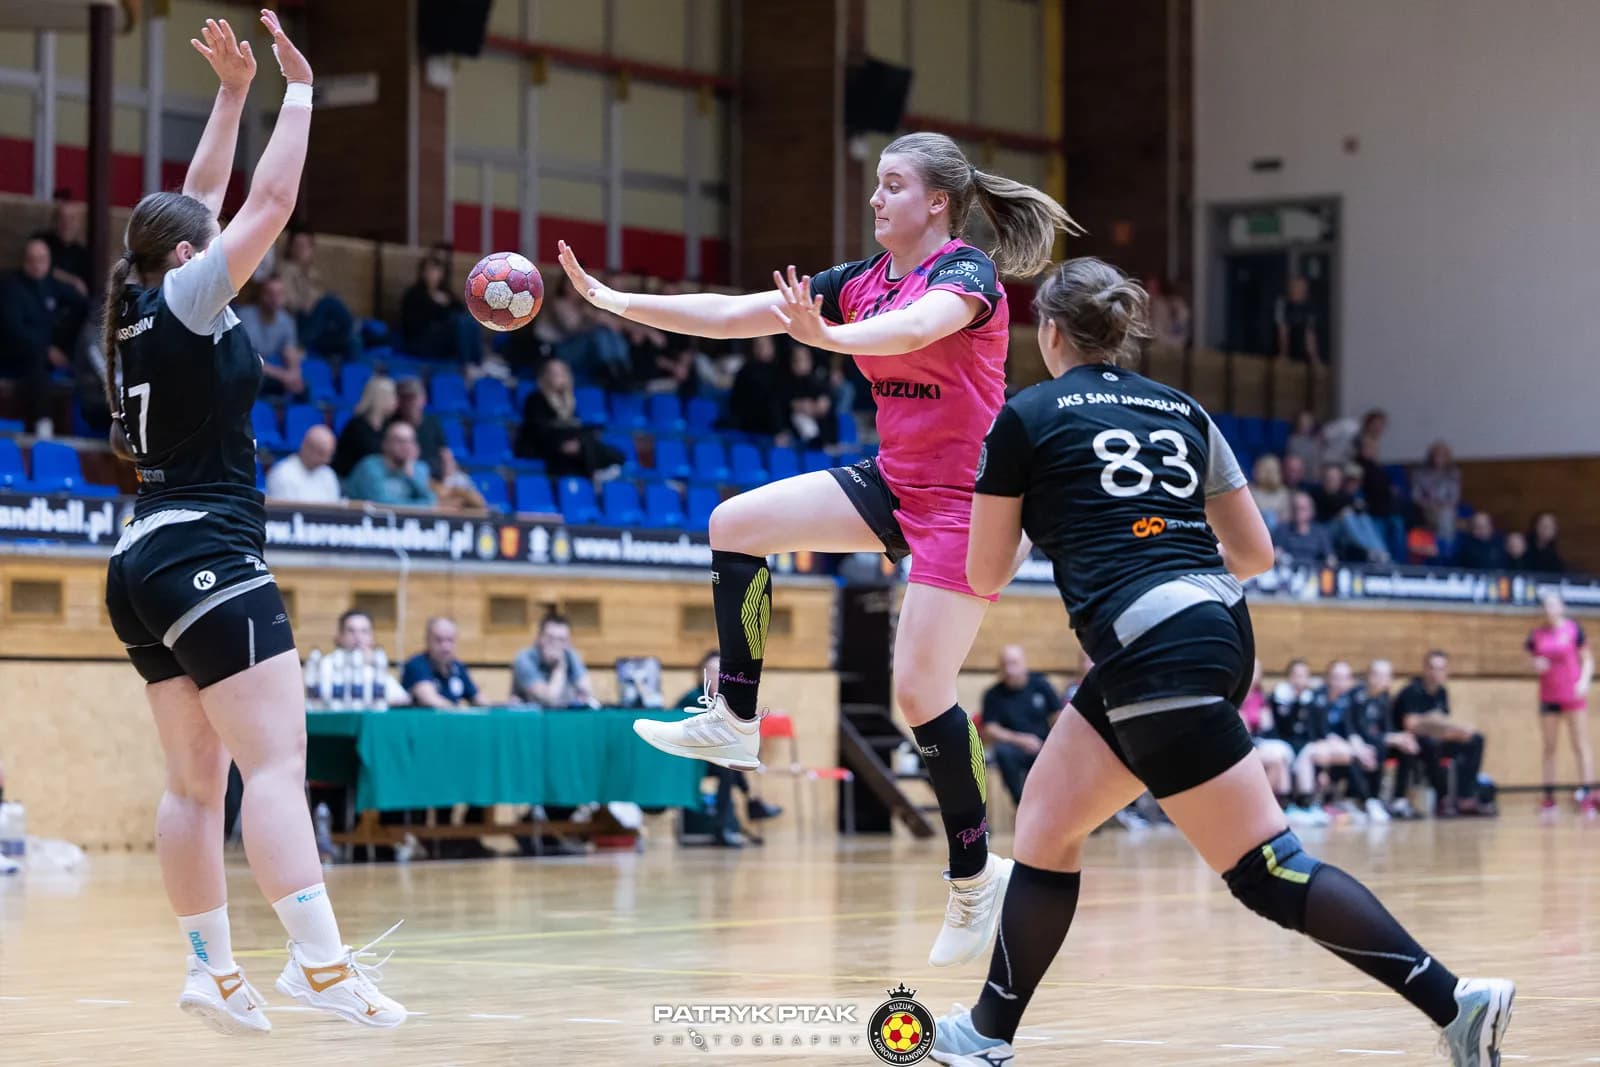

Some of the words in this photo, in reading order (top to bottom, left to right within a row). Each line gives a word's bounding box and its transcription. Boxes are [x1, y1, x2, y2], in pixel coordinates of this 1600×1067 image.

[939, 269, 985, 292] PROFIKA
[1056, 393, 1084, 409] JKS
[1085, 392, 1119, 405] SAN
[1092, 428, 1199, 499] 83
